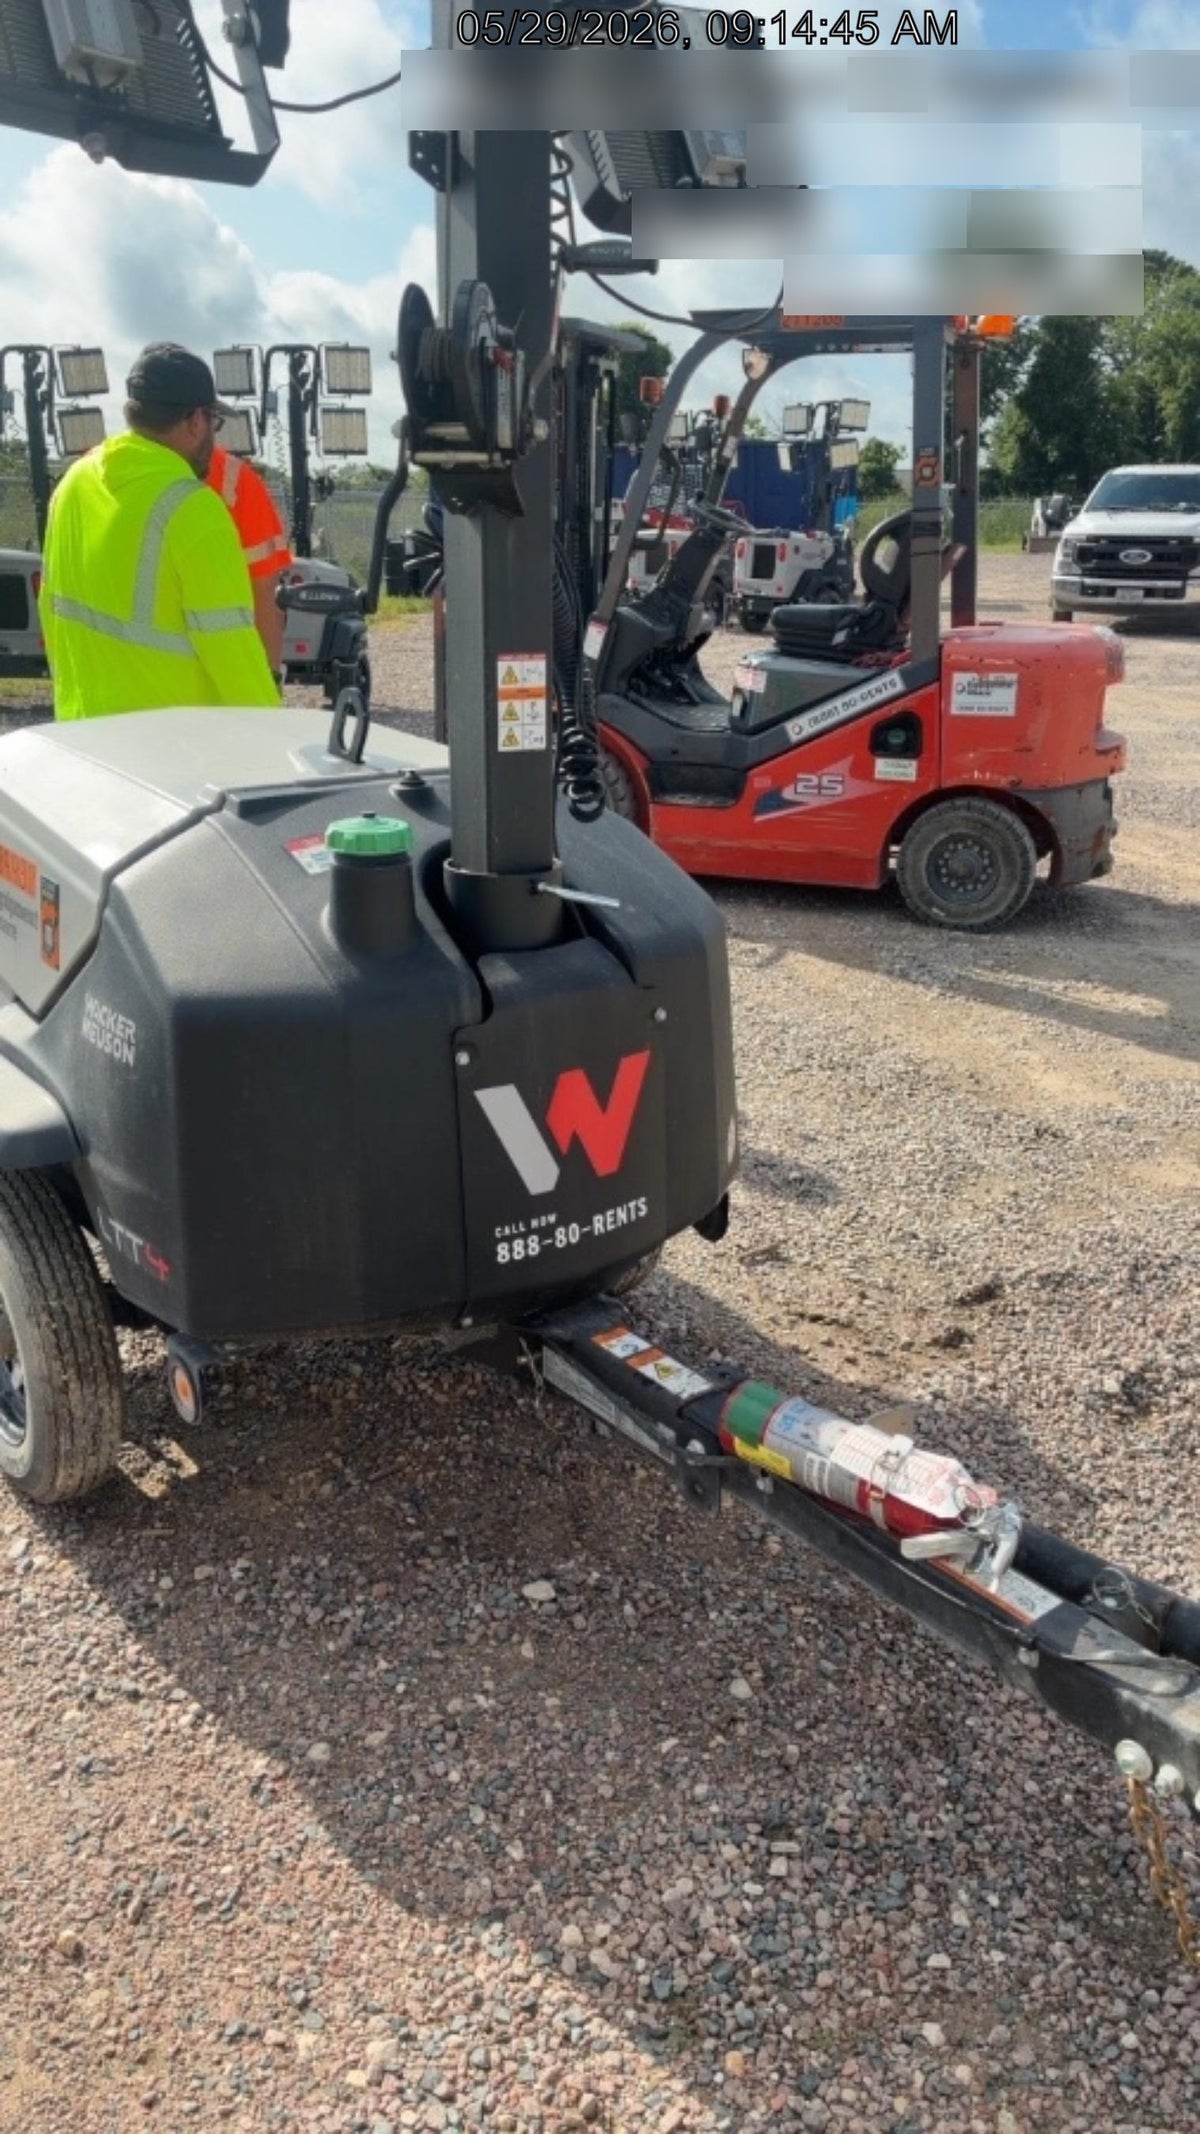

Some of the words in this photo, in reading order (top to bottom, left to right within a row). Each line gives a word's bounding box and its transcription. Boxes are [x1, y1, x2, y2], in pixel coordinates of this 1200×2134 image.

[794, 773, 844, 796] 25
[494, 1221, 526, 1239] CALL
[530, 1213, 558, 1230] NOW
[496, 1197, 649, 1264] 888-80-RENTS
